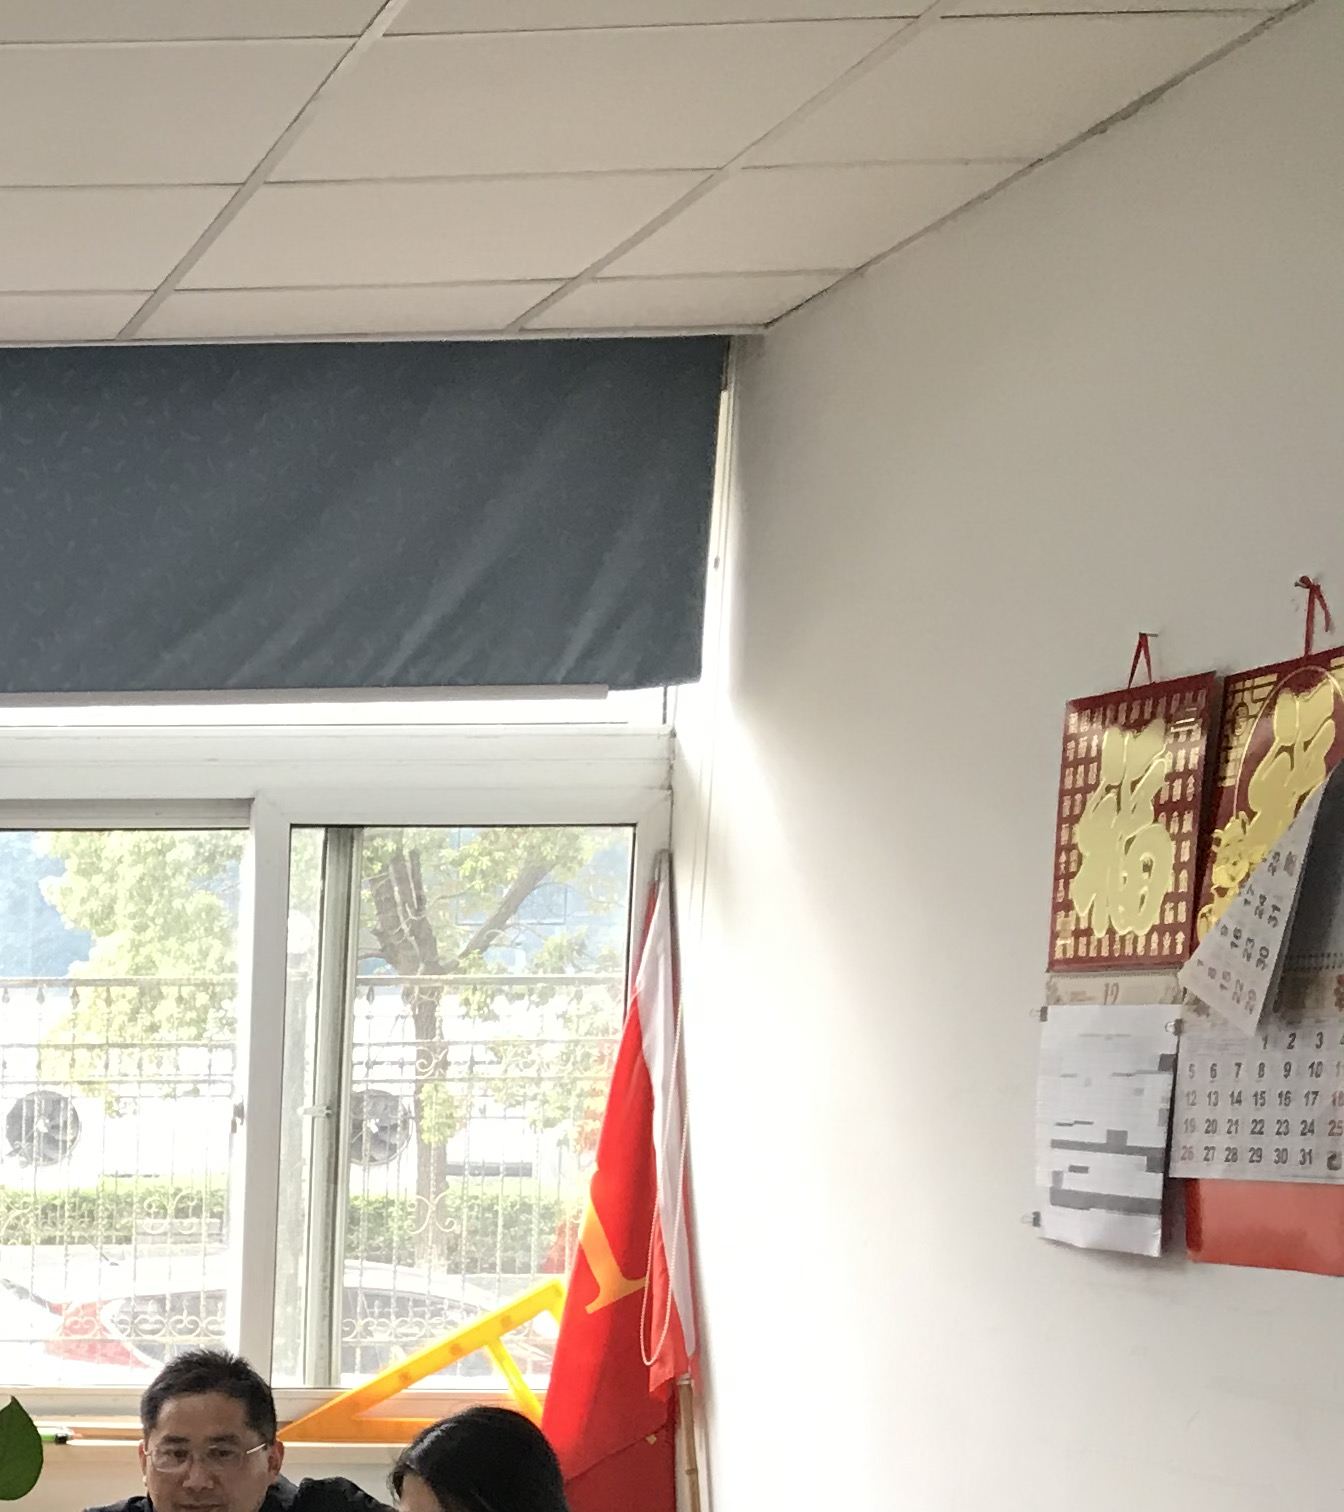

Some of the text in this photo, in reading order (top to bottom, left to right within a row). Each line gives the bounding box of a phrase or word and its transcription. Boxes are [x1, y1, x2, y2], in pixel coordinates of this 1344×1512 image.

[1230, 926, 1242, 949] 16
[1255, 946, 1269, 971] 30
[1267, 904, 1281, 928] 31
[1242, 937, 1255, 962] 23
[1262, 1034, 1269, 1050] 1
[1286, 1032, 1297, 1050] 2
[1315, 1031, 1324, 1049] 3
[1188, 1063, 1195, 1079] 5
[1209, 1062, 1218, 1079] 6
[1234, 1062, 1243, 1078] 7
[1257, 1061, 1266, 1079] 8
[1283, 1061, 1292, 1079] 9
[1308, 1060, 1324, 1079] 10
[1185, 1090, 1198, 1107] 12
[1206, 1090, 1219, 1107] 13
[1229, 1090, 1243, 1107] 14
[1252, 1090, 1266, 1107] 15
[1277, 1090, 1292, 1107] 16
[1303, 1090, 1320, 1107] 17
[1183, 1118, 1344, 1137] 19 20 21 22 23 24 25
[1180, 1145, 1313, 1166] 26 27 28 29 30 31
